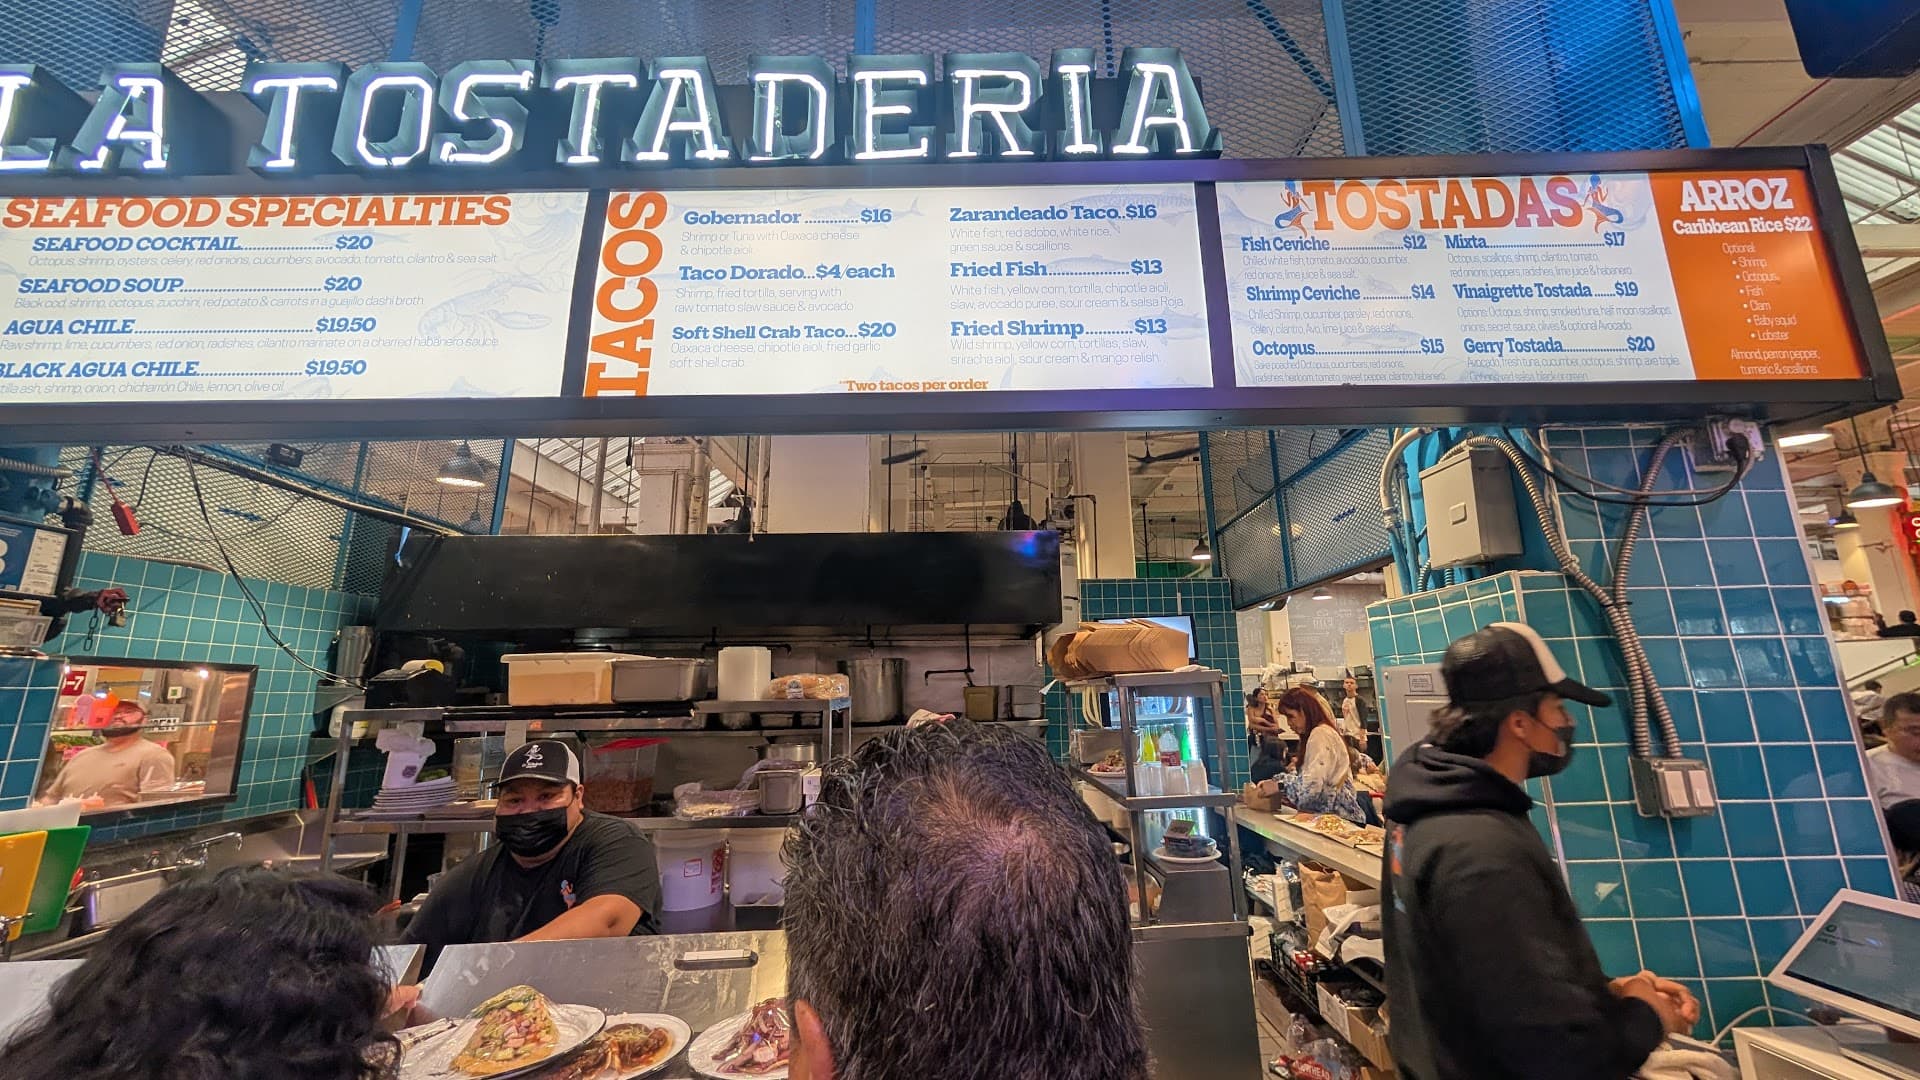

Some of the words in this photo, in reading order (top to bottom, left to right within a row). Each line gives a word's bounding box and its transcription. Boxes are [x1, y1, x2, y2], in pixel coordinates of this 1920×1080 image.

[0, 70, 168, 169] LA
[246, 60, 1210, 169] TOSTADERIA
[1301, 176, 1583, 231] TOSTADAS
[1680, 178, 1794, 211] ARROZ
[2, 196, 222, 228] SEAFOOD
[225, 194, 512, 228] SPECIALTIES
[683, 210, 802, 225] Gobernador
[860, 208, 892, 223] $16
[950, 204, 1068, 222] Zarandeado
[1071, 204, 1118, 221] Taco
[1672, 218, 1749, 234] Caribbean
[1749, 217, 1784, 232] Rice
[1783, 215, 1813, 232] $22
[32, 236, 134, 251] SEAFOOD
[136, 236, 242, 251] COCKTAIL
[335, 235, 373, 250] $20
[1241, 236, 1271, 251] Fish
[1272, 235, 1330, 251] Ceviche
[1403, 235, 1428, 250] $12
[1444, 234, 1488, 249] Mixta
[1603, 231, 1626, 247] $17
[679, 266, 727, 281] Taco
[730, 264, 805, 280] Dorado
[950, 261, 1003, 277] Fried
[1005, 261, 1048, 276] Fish
[1131, 259, 1163, 276] $13
[18, 278, 121, 293] SEAFOOD
[123, 278, 184, 293] SOUP
[324, 276, 362, 291] $20
[583, 191, 668, 397] TACOS
[1453, 283, 1533, 302] Vinaigrette
[1534, 282, 1592, 298] Tostada
[1614, 281, 1639, 297] $19
[1246, 286, 1300, 305] Shrimp
[1302, 285, 1361, 300] Ceviche
[1411, 284, 1435, 299] $14
[3, 319, 64, 335] AGUA
[68, 319, 136, 334] CHILE
[316, 317, 376, 333] $19.50
[672, 326, 711, 340] Soft
[712, 325, 757, 340] Shell
[758, 324, 801, 339] Crab
[803, 324, 847, 339] Taco
[858, 322, 897, 338] $20
[951, 320, 1004, 336] Fried
[1007, 320, 1085, 339] Shrimp
[1134, 318, 1168, 334] $13
[1253, 340, 1316, 359] Octopus
[1420, 338, 1445, 354] $15
[1463, 338, 1504, 357] Gerry
[1505, 337, 1563, 353] Tostada
[1626, 336, 1655, 353] $20
[66, 362, 127, 378] AGUA
[131, 361, 200, 377] CHILE
[305, 359, 367, 376] $19.50
[879, 380, 919, 390] tacos
[922, 381, 946, 391] per
[949, 379, 988, 390] order
